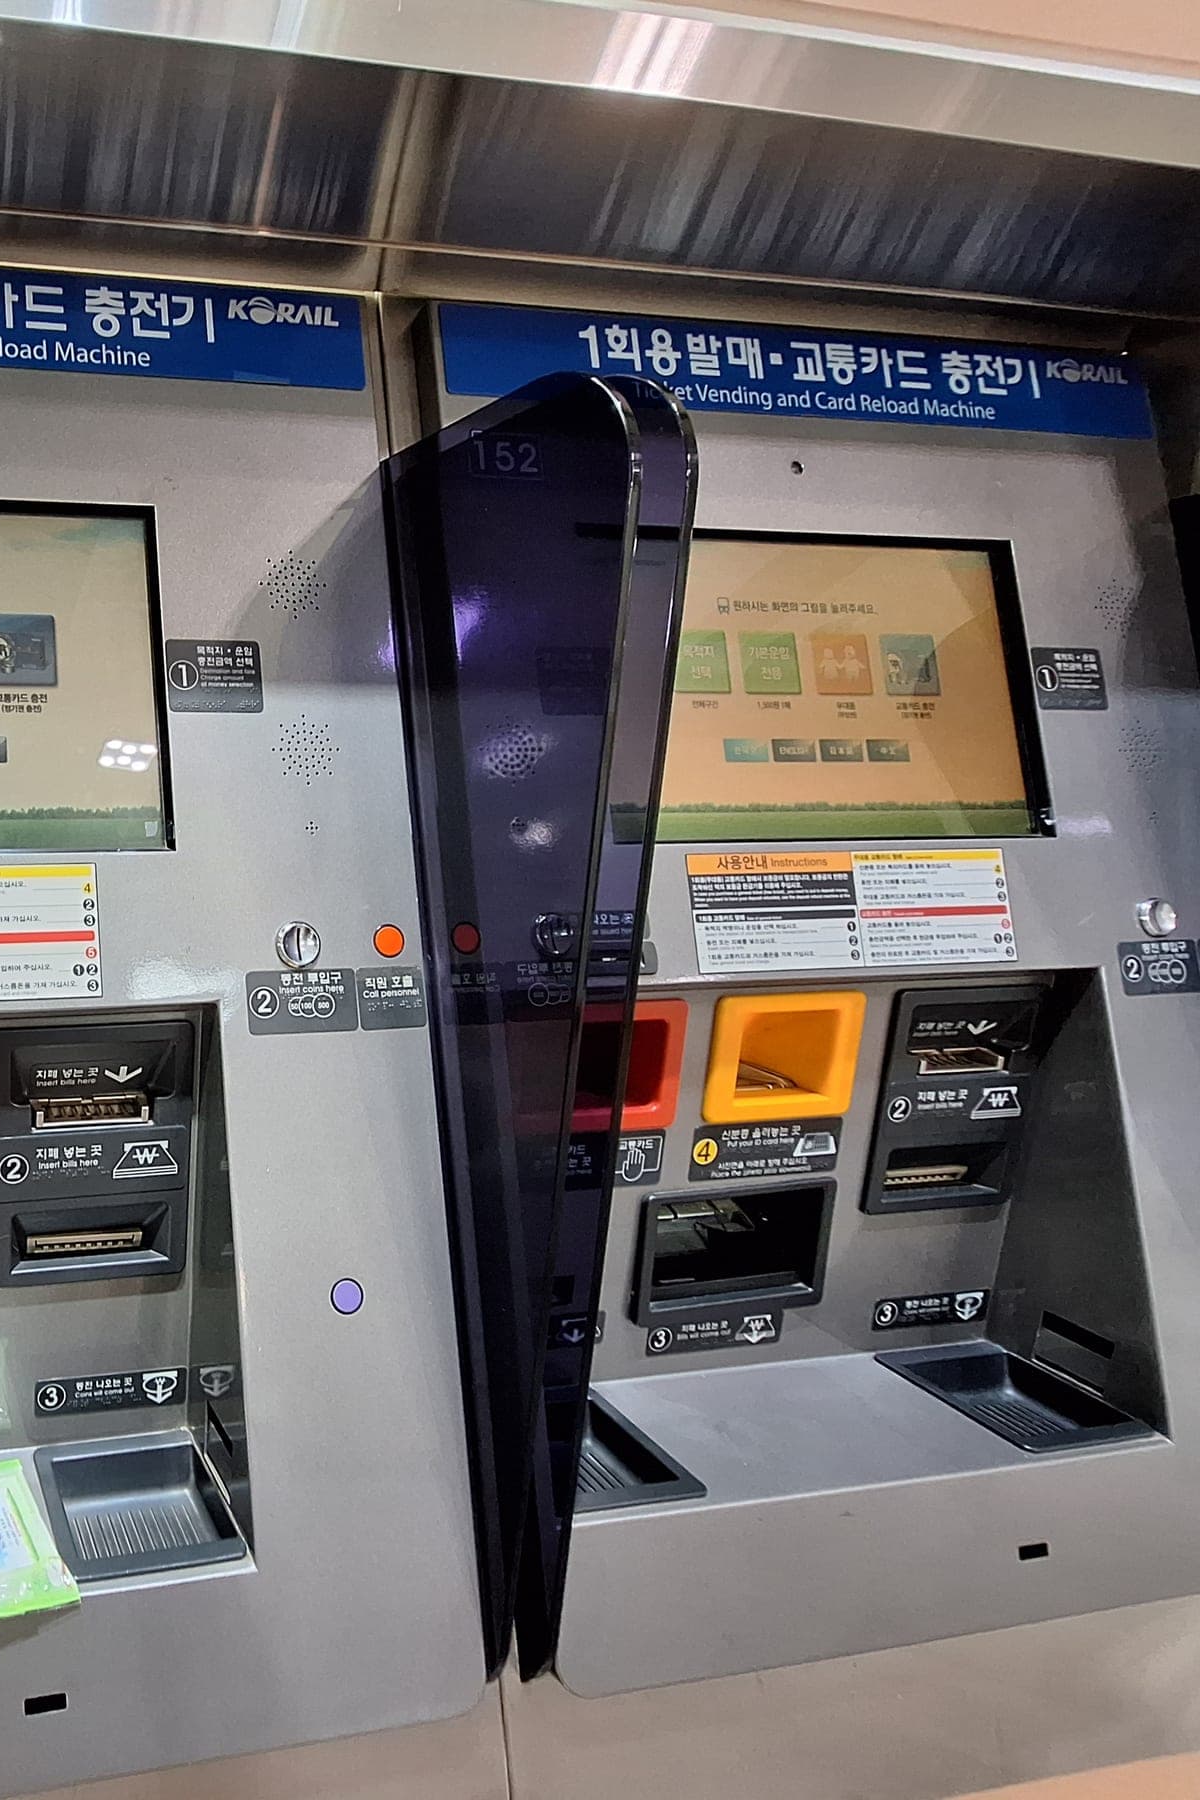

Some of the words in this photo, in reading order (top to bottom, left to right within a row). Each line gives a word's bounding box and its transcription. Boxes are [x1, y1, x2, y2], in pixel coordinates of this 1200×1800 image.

[84, 287, 215, 343] 충전기
[228, 296, 339, 328] KORAIL
[55, 340, 151, 367] Machine
[941, 351, 1041, 398] 충전기
[1046, 357, 1129, 385] KORAIL
[695, 383, 772, 410] Vending
[777, 390, 811, 408] and
[815, 392, 856, 410] Card
[861, 395, 919, 414] Reload
[924, 399, 995, 419] Machine
[474, 438, 539, 474] 152
[716, 855, 768, 870] 사용안내
[770, 857, 828, 868] Instructions
[280, 972, 304, 986] 동전
[307, 971, 342, 985] 투입구
[365, 977, 388, 989] 직원
[391, 975, 413, 988] 호출
[279, 985, 301, 994] Insert
[302, 985, 325, 993] coins
[325, 984, 345, 993] here
[363, 990, 379, 999] Call
[380, 988, 419, 999] personnel
[36, 1068, 58, 1079] 지폐
[62, 1067, 83, 1078] 넣는
[87, 1066, 99, 1077] 곳
[36, 1078, 58, 1087] Insert
[60, 1077, 76, 1086] bills
[77, 1077, 96, 1086] here
[36, 1148, 59, 1160] 지폐
[63, 1146, 86, 1158] 넣는
[90, 1144, 102, 1156] 곳
[38, 1160, 60, 1170] Insert
[62, 1159, 78, 1169] bills
[79, 1158, 99, 1168] here
[95, 1378, 121, 1390] 나오는
[124, 1376, 133, 1387] 곳
